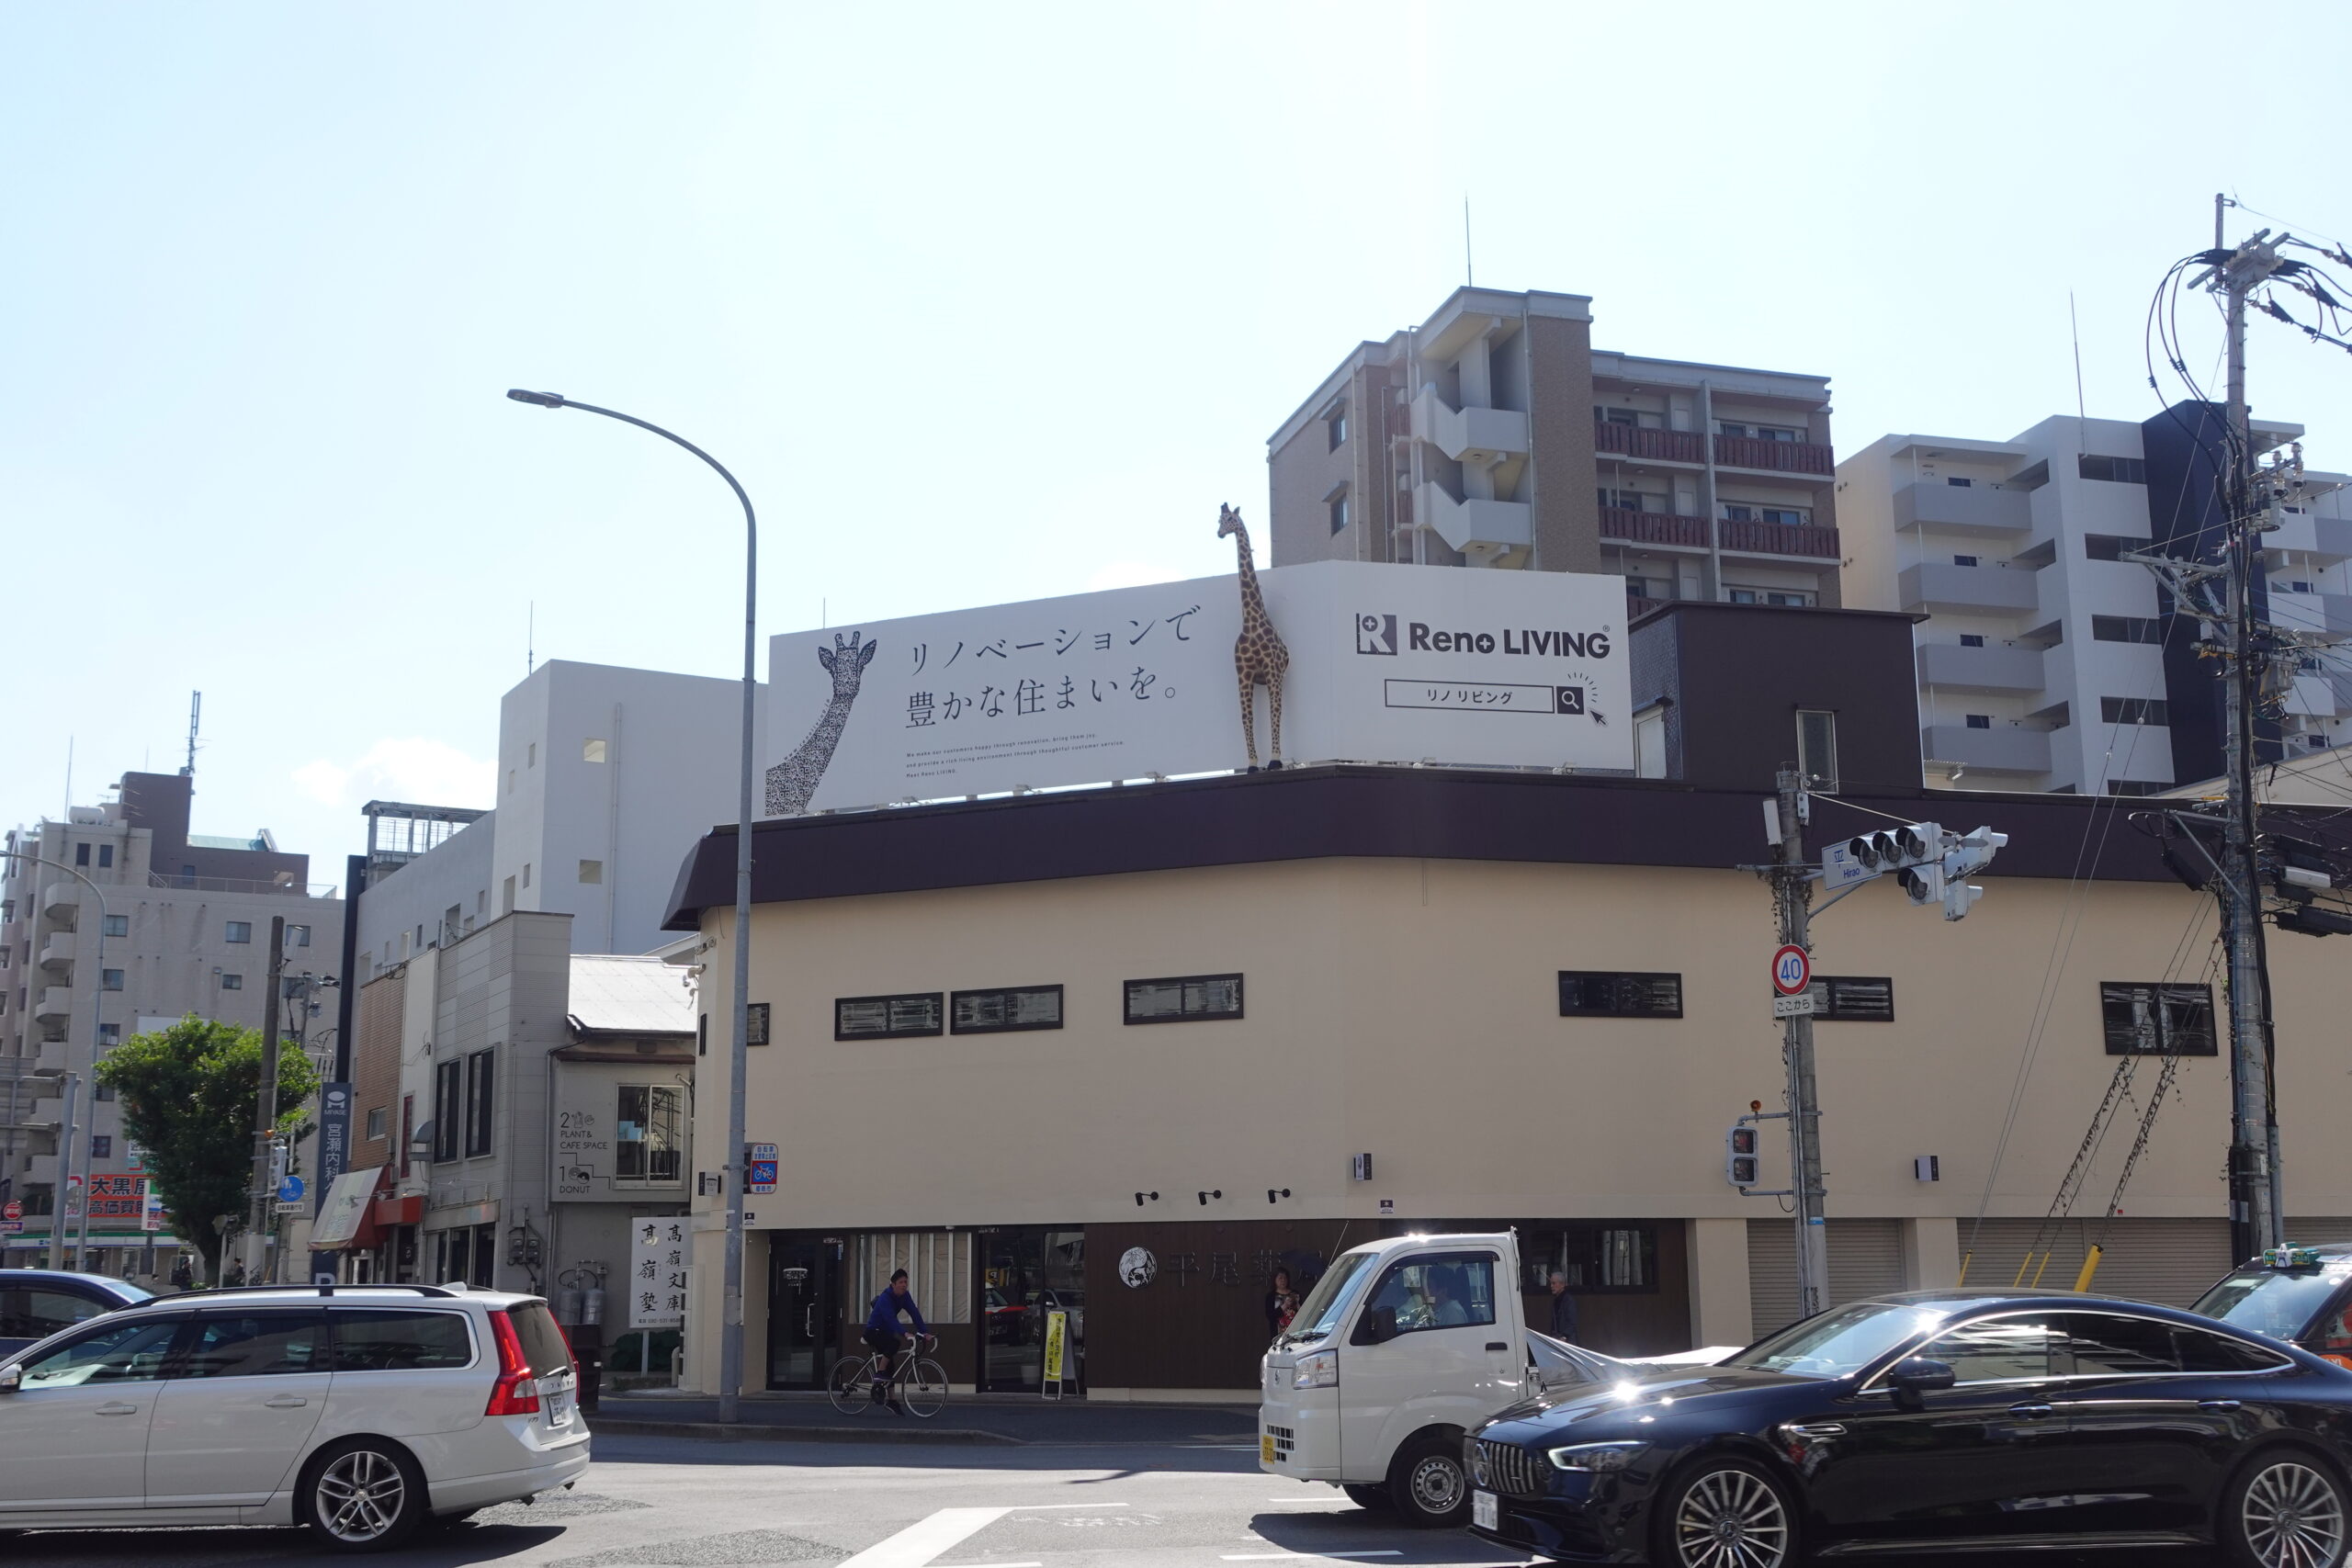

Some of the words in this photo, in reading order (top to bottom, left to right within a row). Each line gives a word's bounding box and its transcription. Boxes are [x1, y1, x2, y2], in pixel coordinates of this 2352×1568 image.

[910, 604, 1202, 677] リノベーションで
[1409, 622, 1496, 654] Reno
[904, 666, 1177, 728] 豊かな住まいを。
[1427, 689, 1513, 705] リノリビング
[993, 740, 1016, 749] through
[1843, 867, 1861, 879] Hirao
[1781, 958, 1802, 981] 40
[1777, 998, 1810, 1012] ここから
[560, 1111, 570, 1128] 2
[560, 1141, 581, 1149] CAFE
[582, 1141, 608, 1149] SPACE
[559, 1166, 565, 1182] 1
[559, 1185, 591, 1194] DONUT
